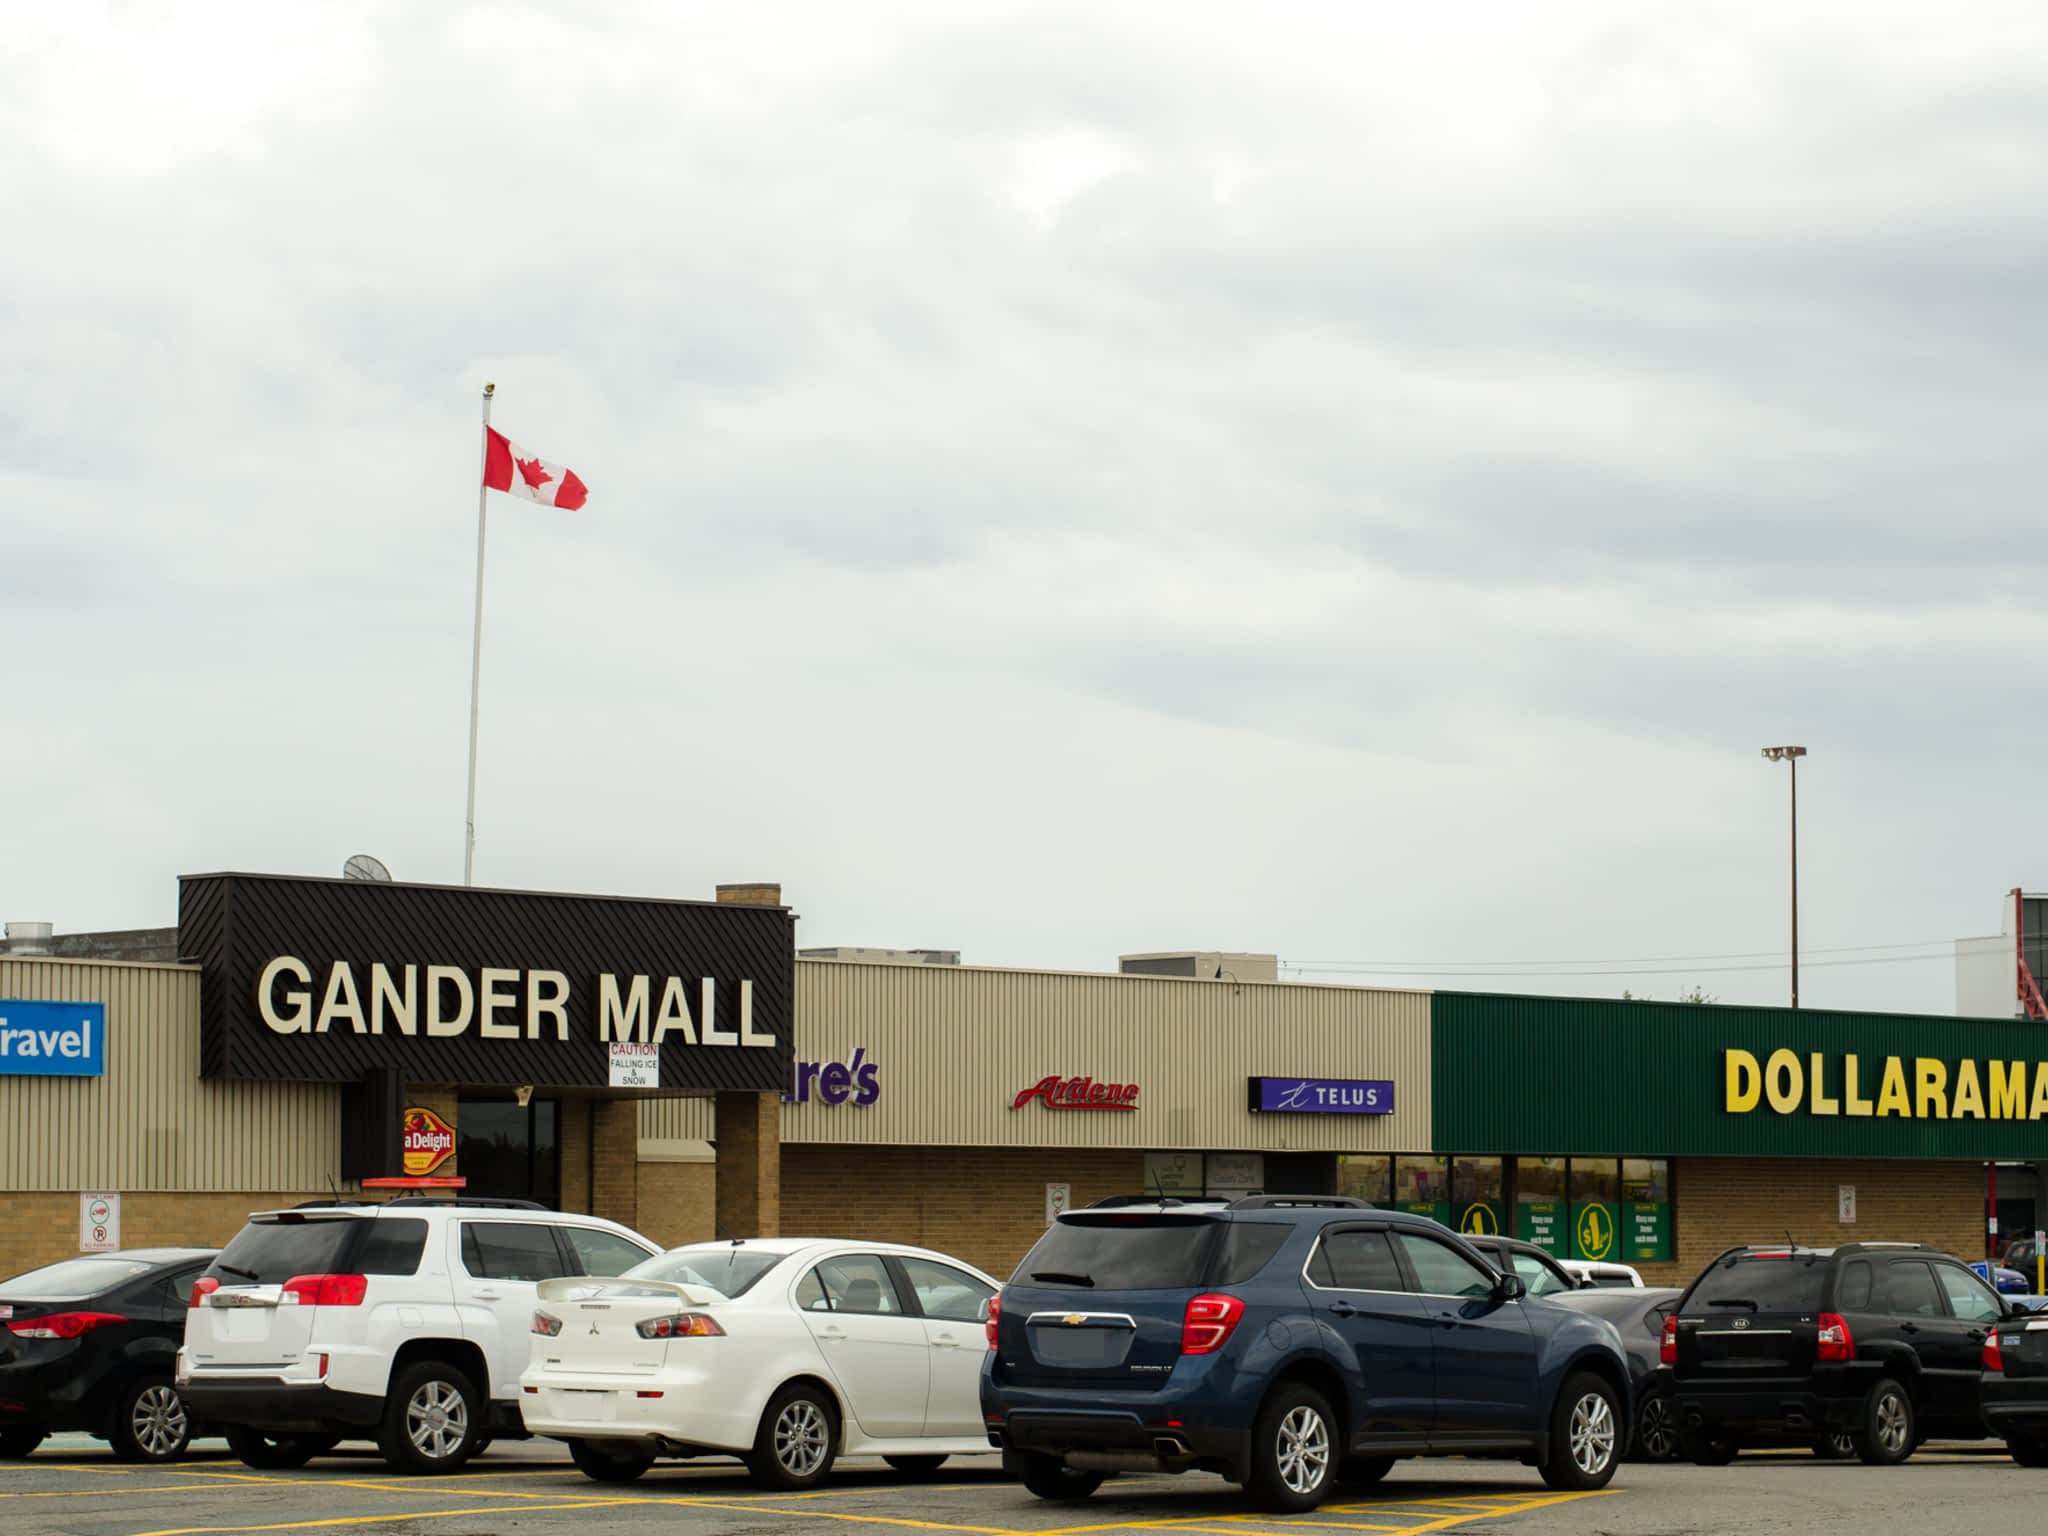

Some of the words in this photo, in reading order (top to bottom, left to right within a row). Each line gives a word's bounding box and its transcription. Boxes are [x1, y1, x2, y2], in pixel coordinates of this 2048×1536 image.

[258, 955, 571, 1041] GANDER
[600, 972, 776, 1047] MALL
[611, 1043, 657, 1056] CAUTION
[611, 1059, 644, 1068] FALLING
[645, 1060, 657, 1069] ICE
[622, 1076, 646, 1085] SNOW
[1013, 1075, 1140, 1110] Ardene
[1315, 1087, 1378, 1105] TELUS
[413, 1132, 451, 1152] Delight
